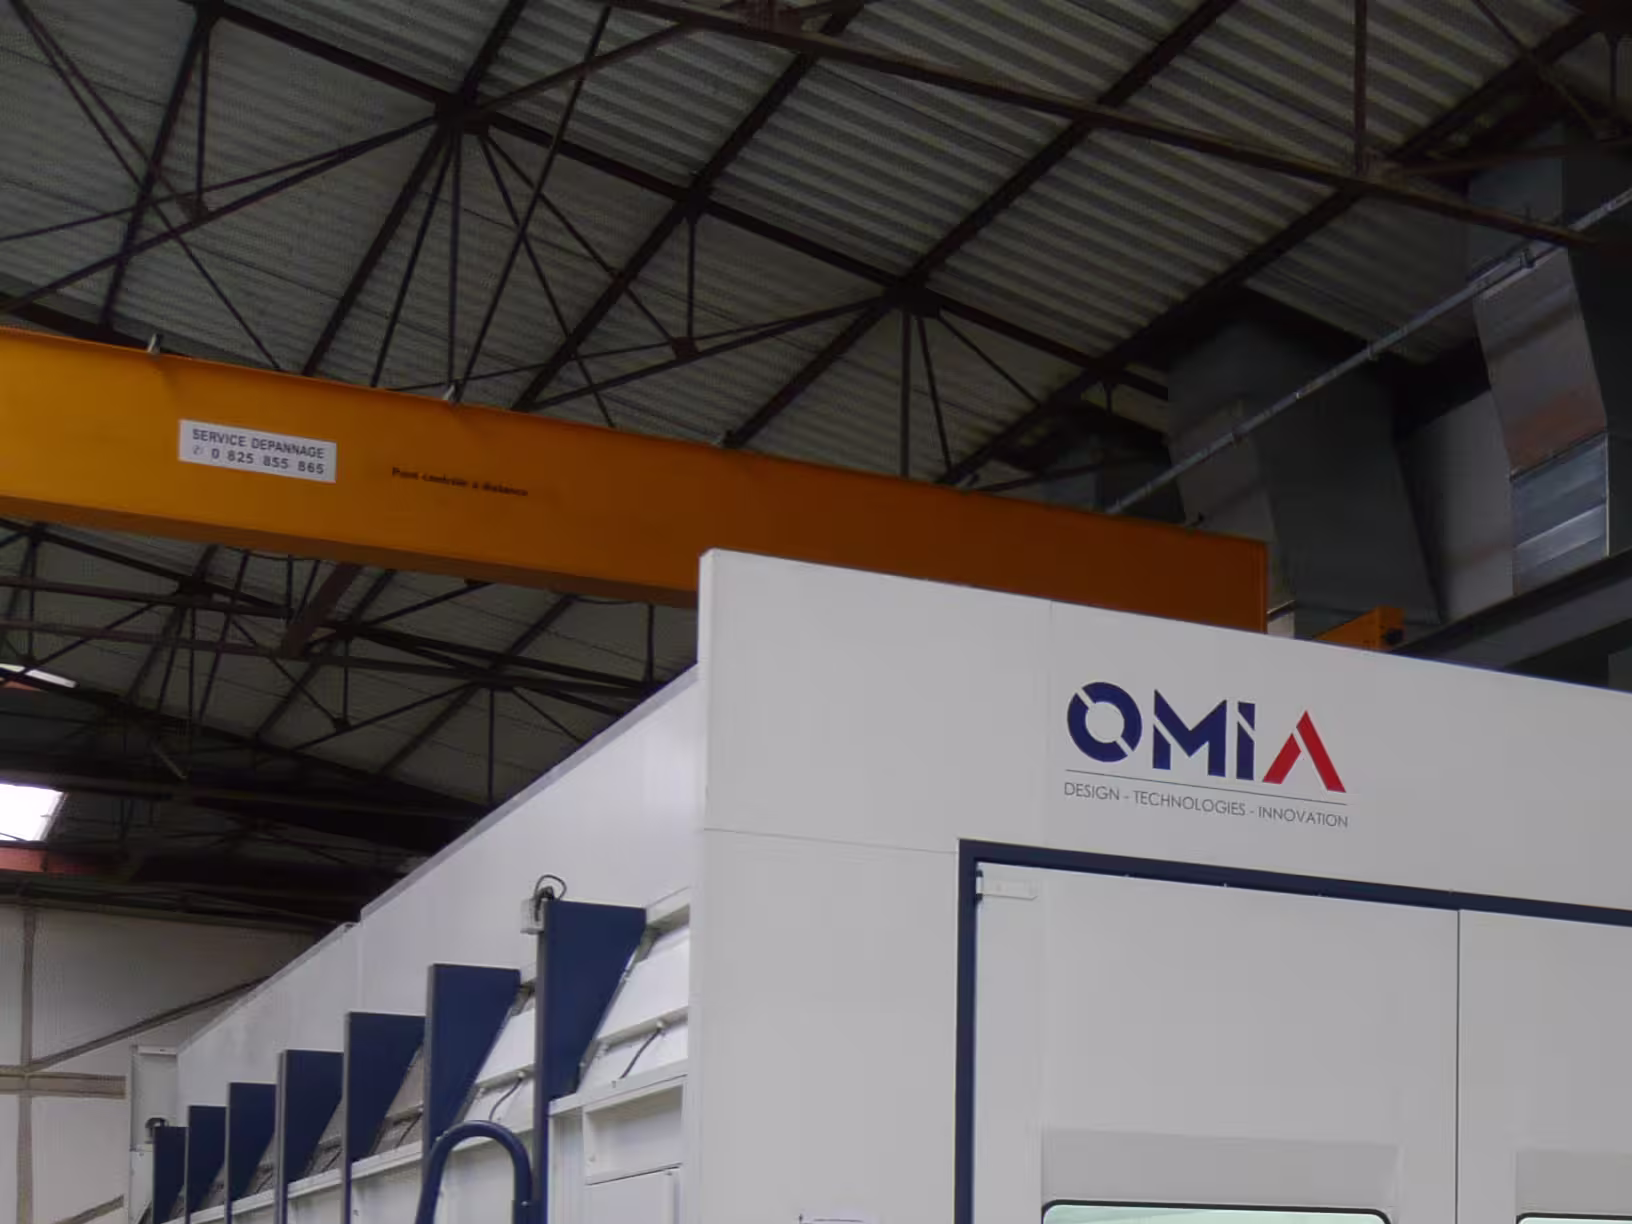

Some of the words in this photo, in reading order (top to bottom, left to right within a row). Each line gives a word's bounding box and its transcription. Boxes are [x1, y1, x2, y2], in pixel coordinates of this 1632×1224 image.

[192, 428, 247, 447] SERVICE
[251, 437, 325, 459] DEPANNAGE
[211, 448, 220, 459] 0
[227, 449, 254, 464] 825
[263, 455, 289, 470] 855
[297, 460, 325, 475] 865
[1067, 681, 1347, 794] OMIA
[1063, 781, 1120, 801] DESIGN
[1133, 790, 1246, 817] TECHNOLOGIES
[1258, 805, 1349, 829] INNOVATION
